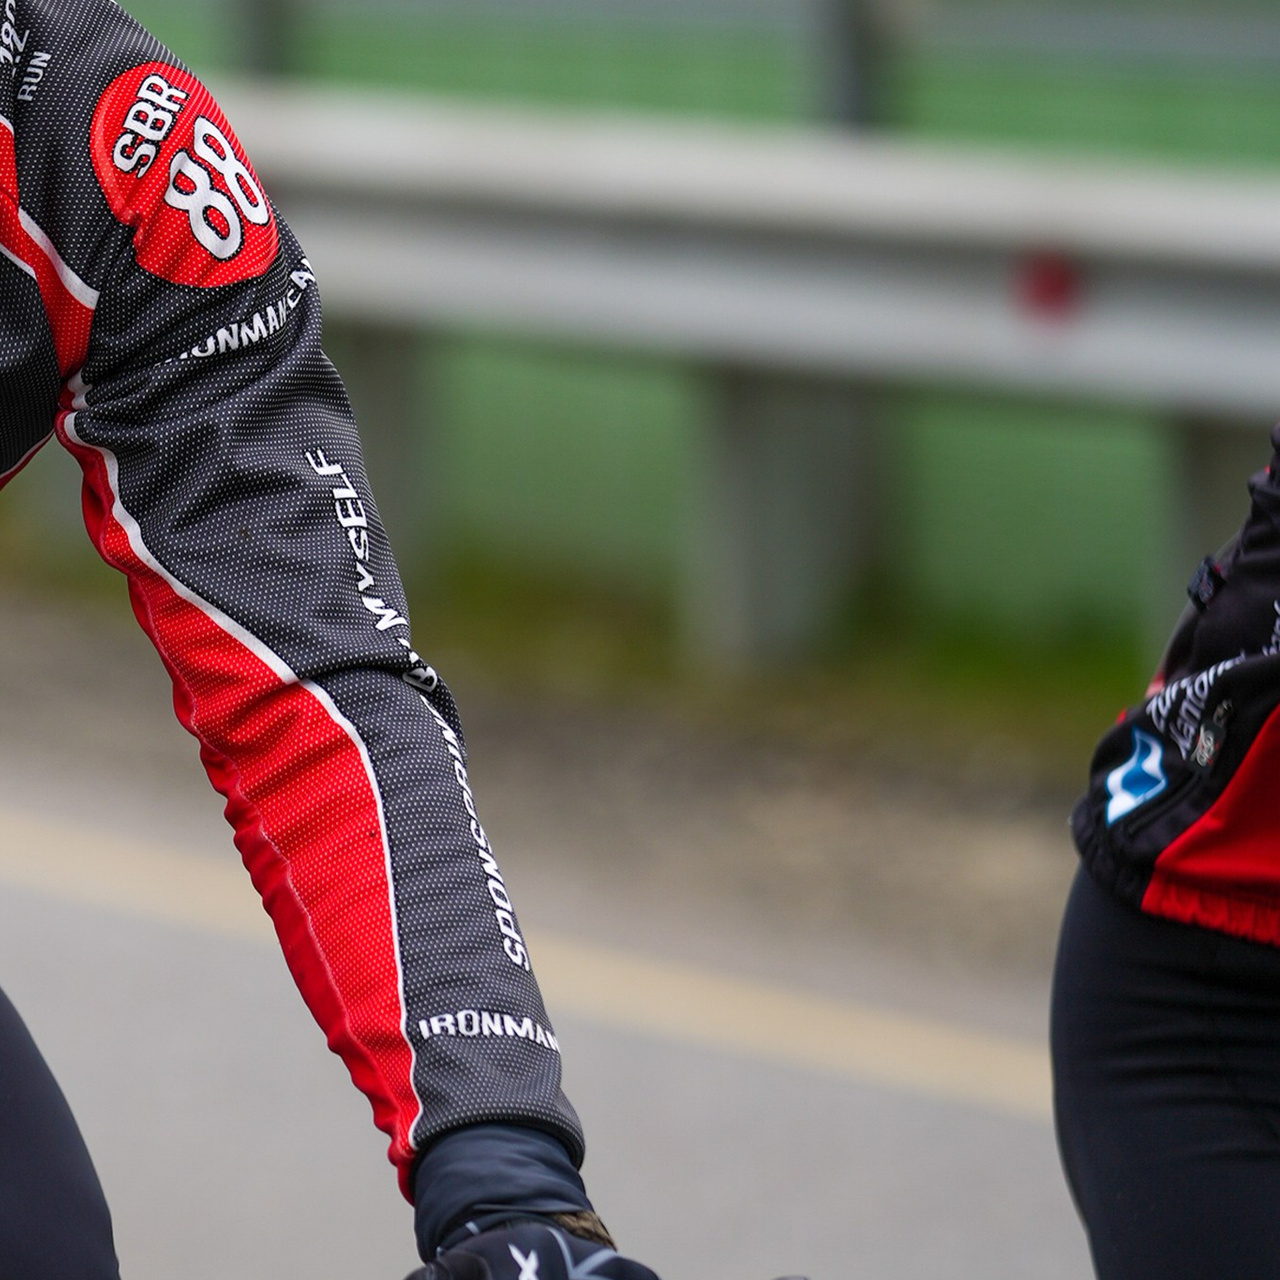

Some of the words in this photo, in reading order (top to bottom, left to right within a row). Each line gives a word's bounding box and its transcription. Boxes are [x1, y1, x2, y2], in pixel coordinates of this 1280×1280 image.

[17, 51, 52, 101] RUN
[111, 72, 192, 180] SBR
[164, 116, 270, 262] 88
[156, 297, 288, 368] ONMAN
[304, 449, 410, 632] MYSELF
[417, 1008, 560, 1054] IRONMAN
